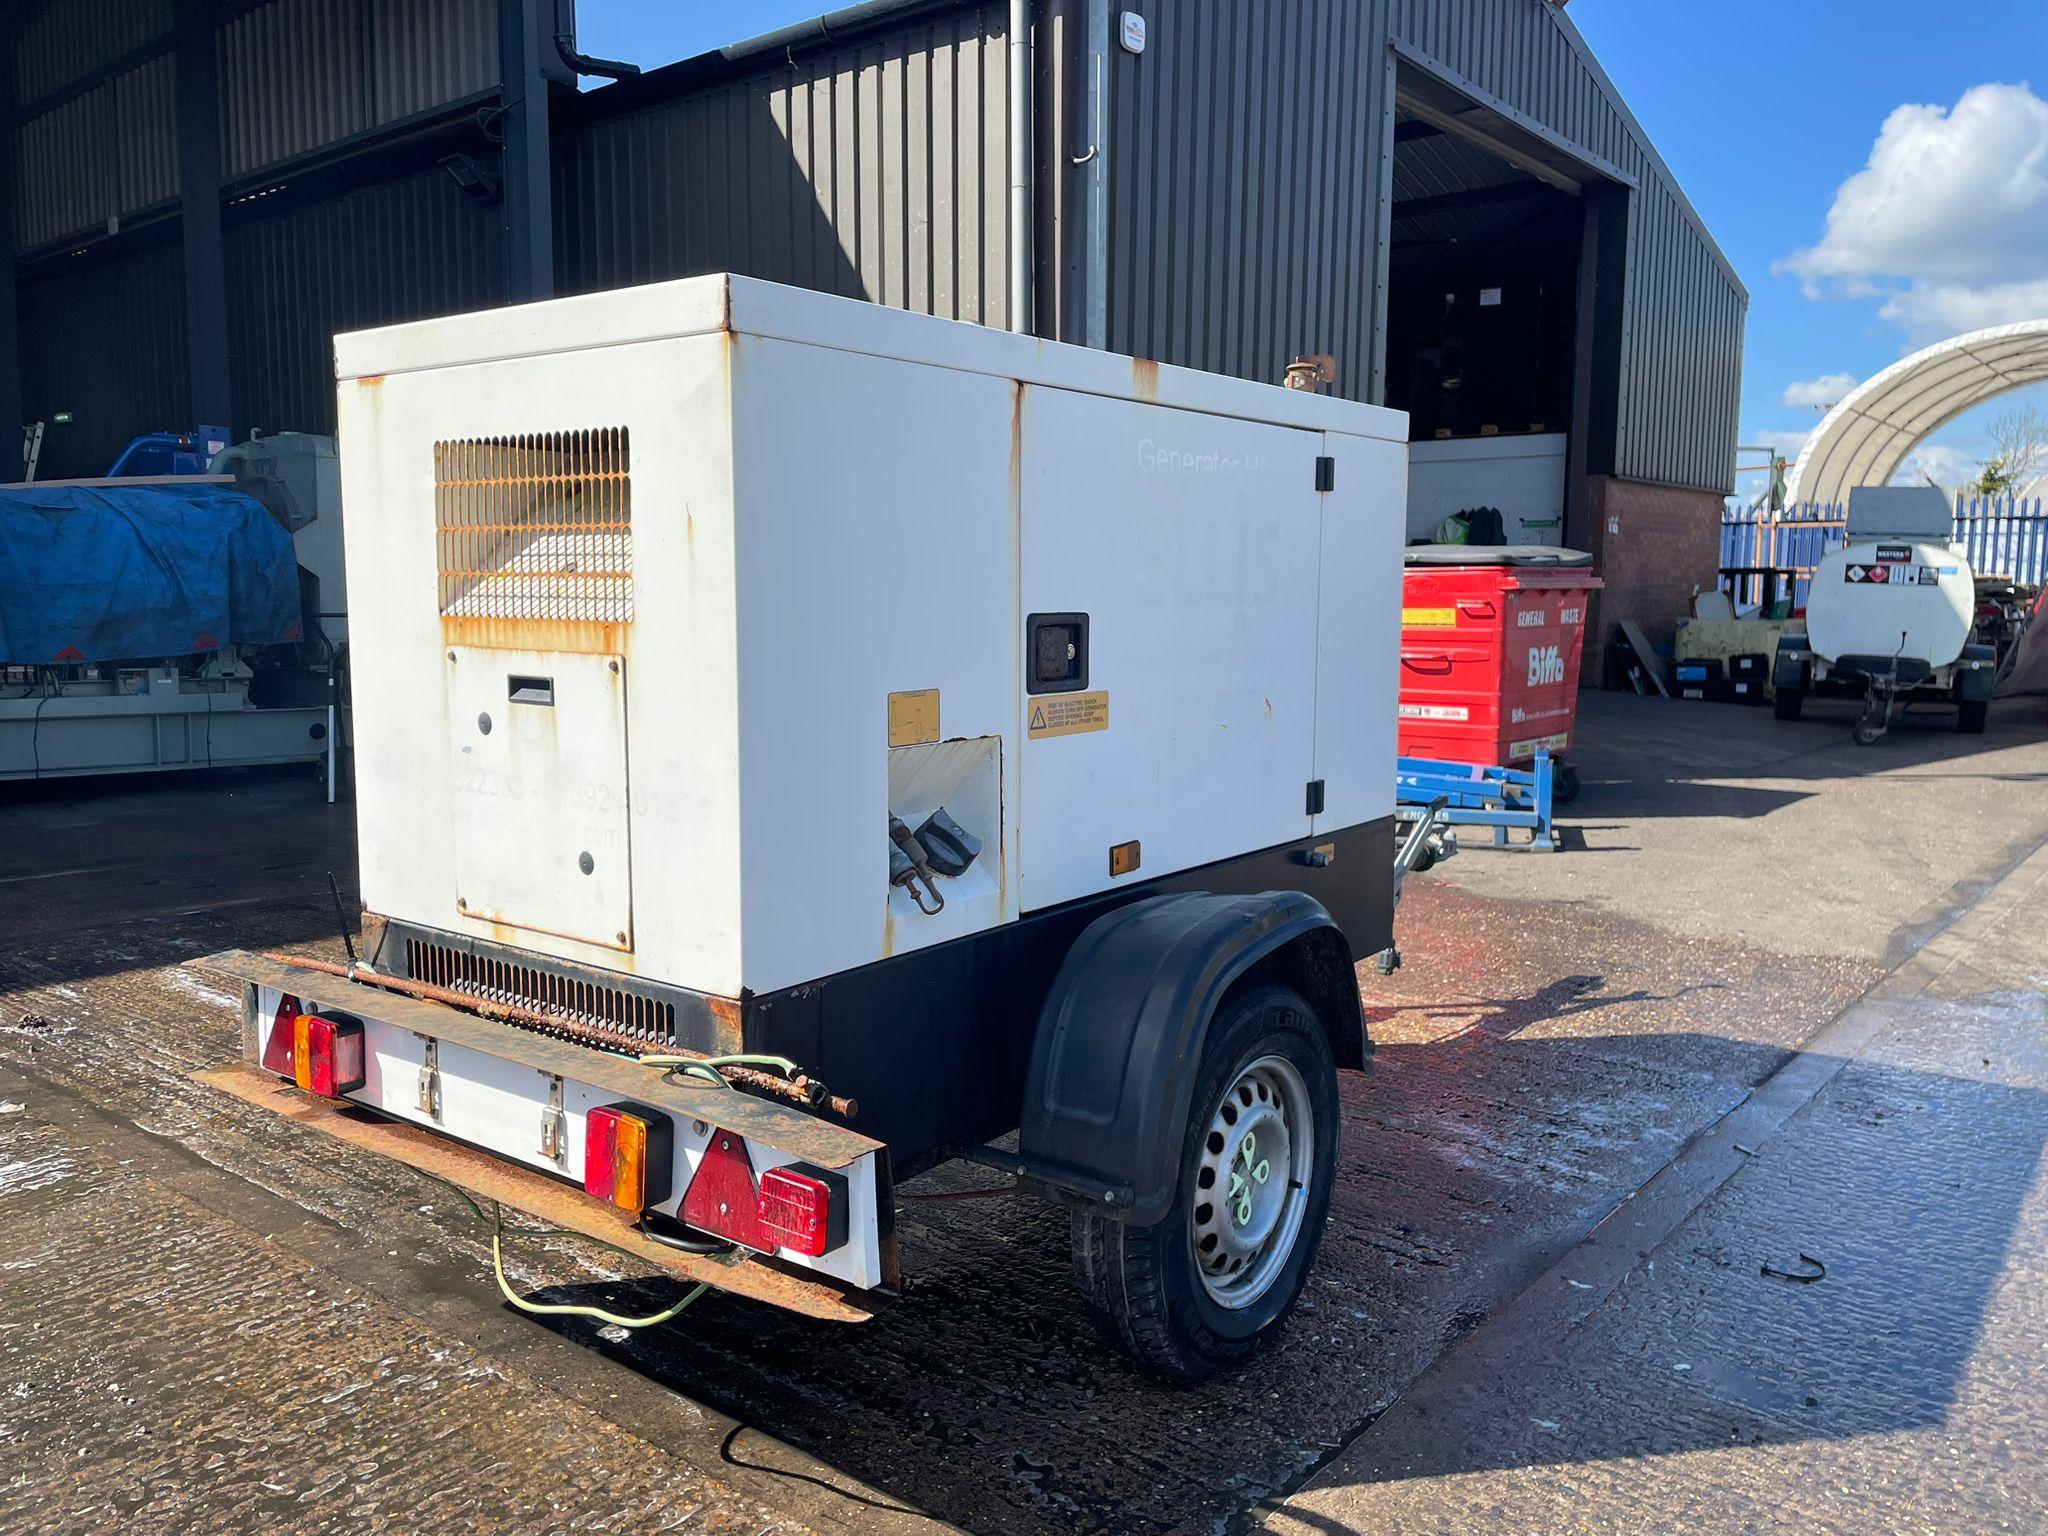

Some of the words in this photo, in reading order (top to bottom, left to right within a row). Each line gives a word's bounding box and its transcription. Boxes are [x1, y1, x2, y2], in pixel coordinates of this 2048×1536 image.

[1137, 437, 1240, 475] Generator
[1517, 609, 1545, 628] GENERAL
[1560, 607, 1580, 625] WASTE
[1526, 644, 1565, 688] Biffa
[1511, 707, 1526, 724] Biffa
